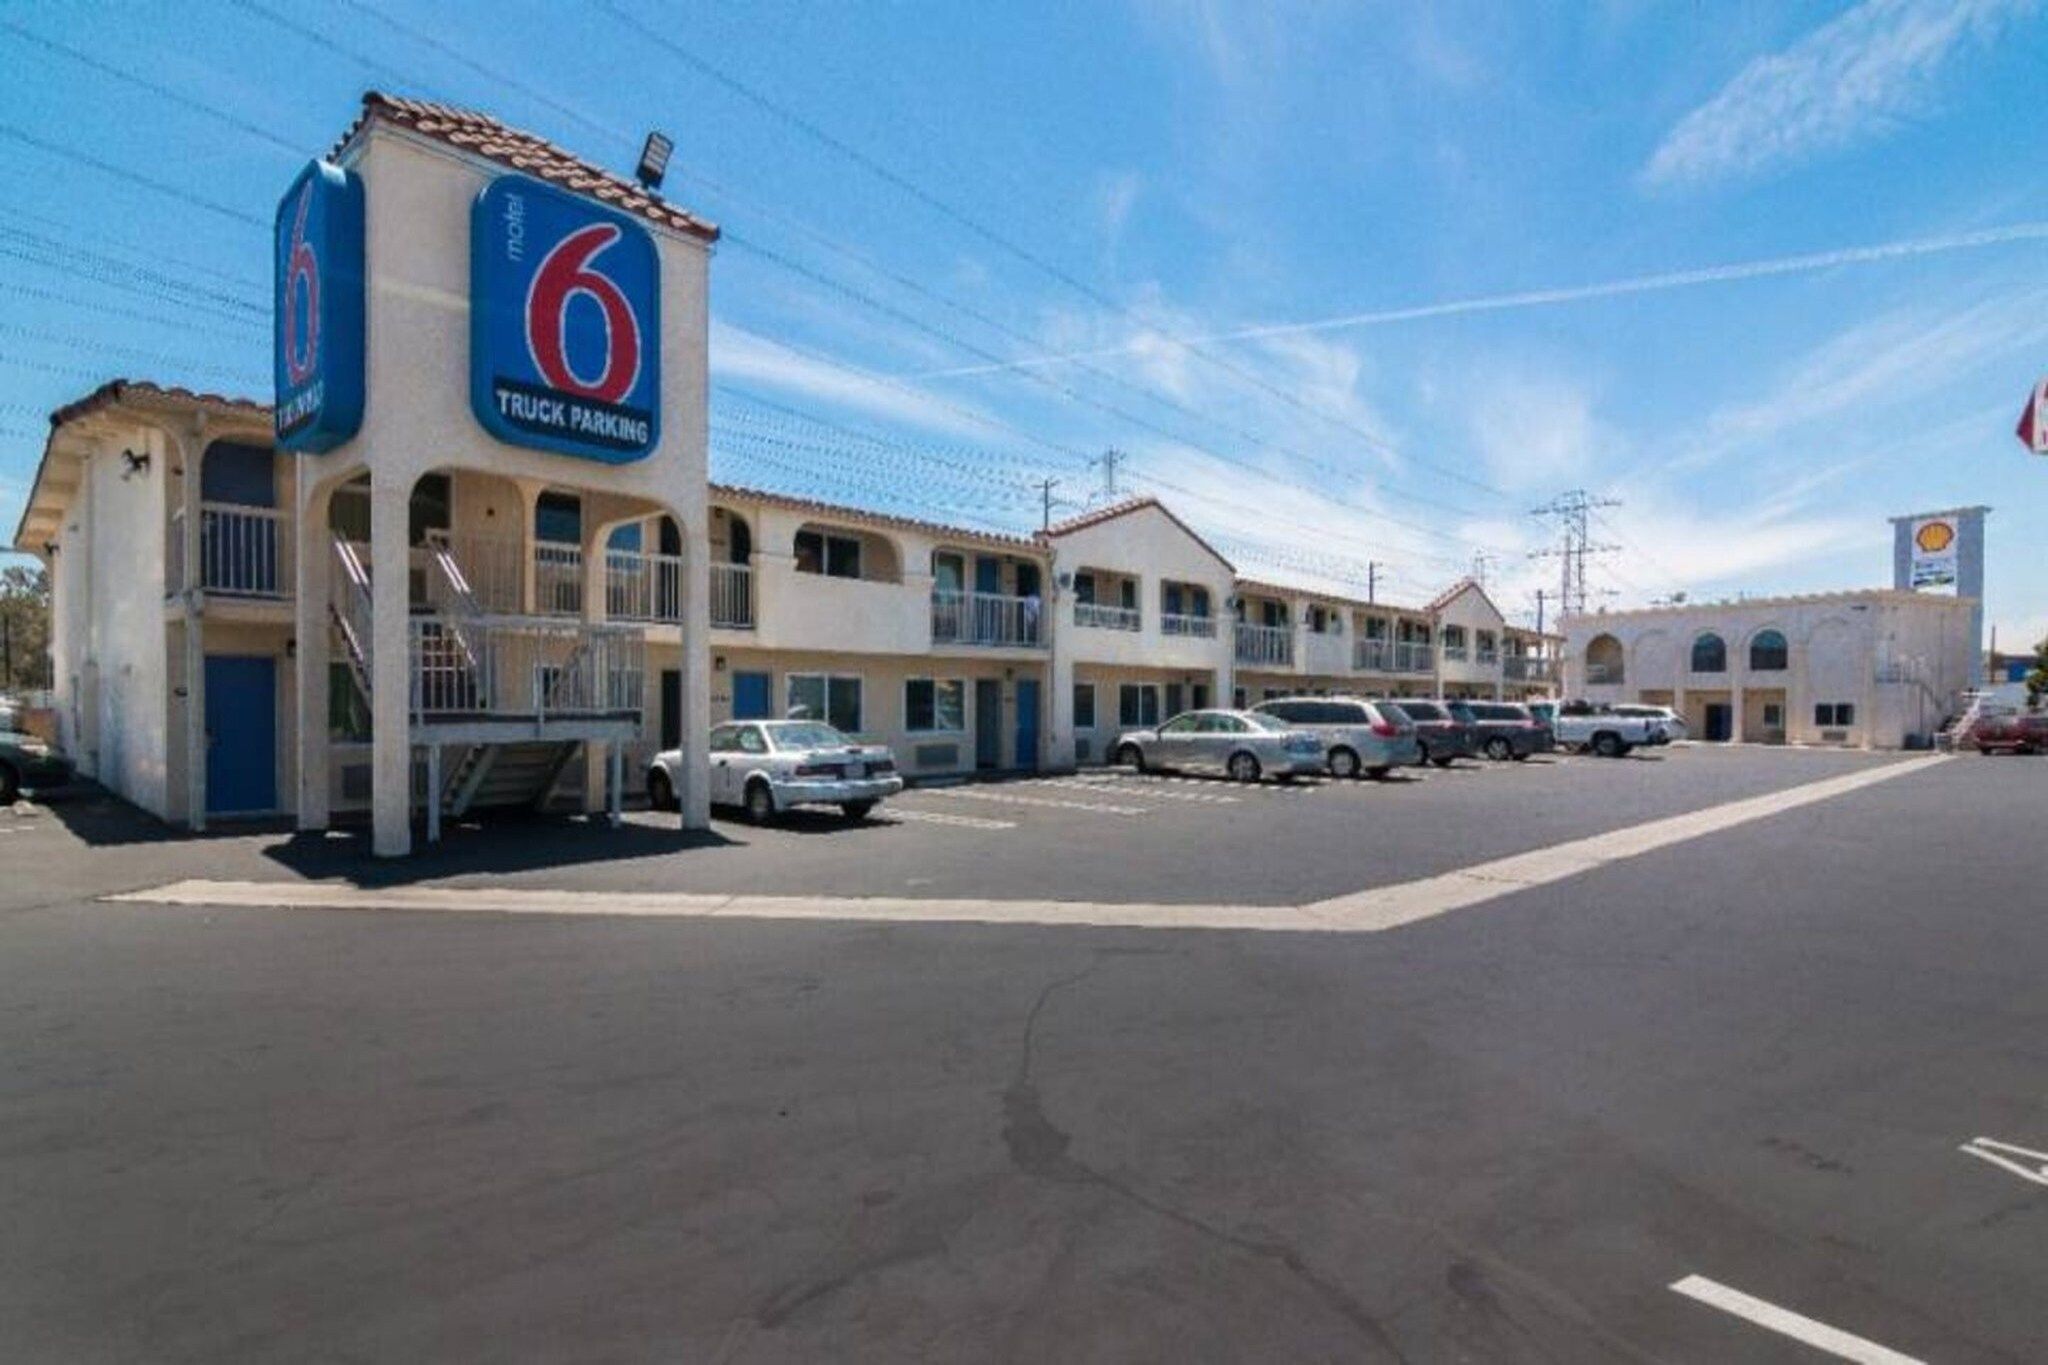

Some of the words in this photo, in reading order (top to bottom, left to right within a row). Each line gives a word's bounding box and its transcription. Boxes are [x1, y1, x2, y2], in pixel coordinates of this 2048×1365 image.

[287, 179, 319, 384] 6
[507, 193, 525, 262] motel
[526, 222, 641, 404] 6
[497, 390, 565, 427] TRUCK
[571, 406, 648, 444] PARKING
